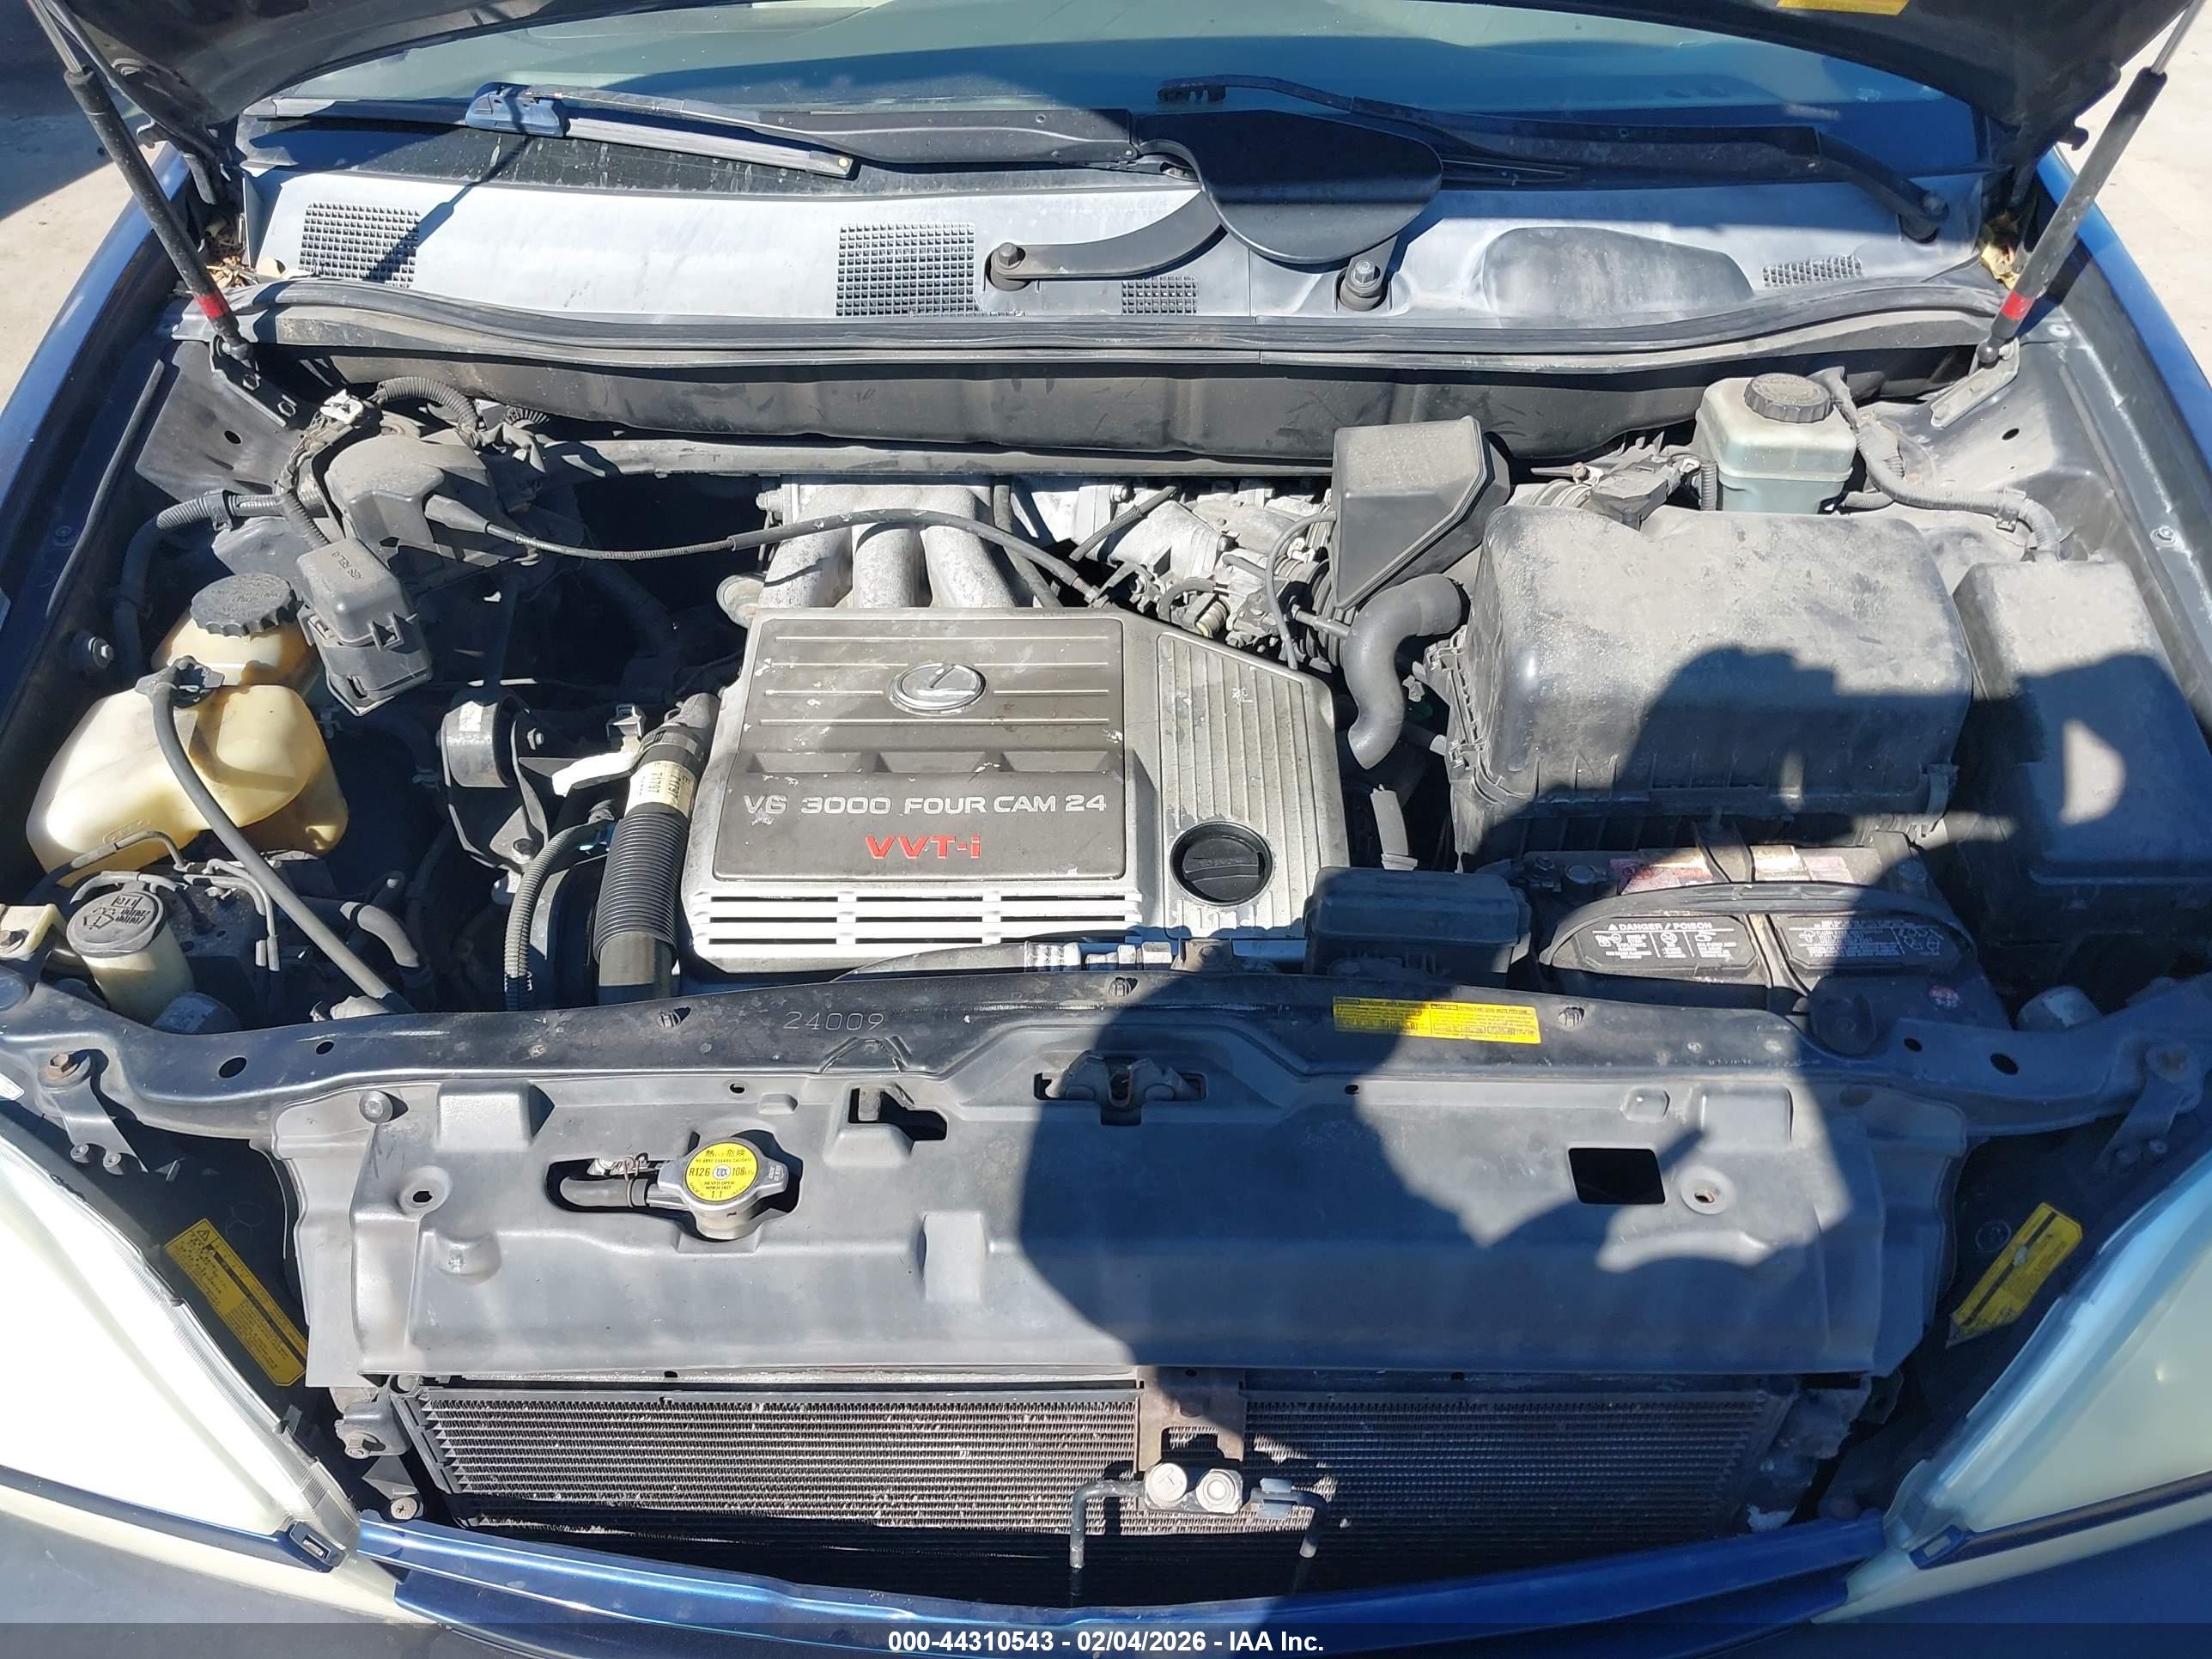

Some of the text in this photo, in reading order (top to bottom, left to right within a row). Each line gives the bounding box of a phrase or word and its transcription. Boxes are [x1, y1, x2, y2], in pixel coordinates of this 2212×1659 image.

[744, 794, 1106, 814] V6 3000 FOUR CAM 24
[865, 834, 981, 860] VVT-i
[1674, 921, 1712, 930] POISON
[783, 1011, 884, 1030] 24009
[689, 1167, 711, 1176] R126
